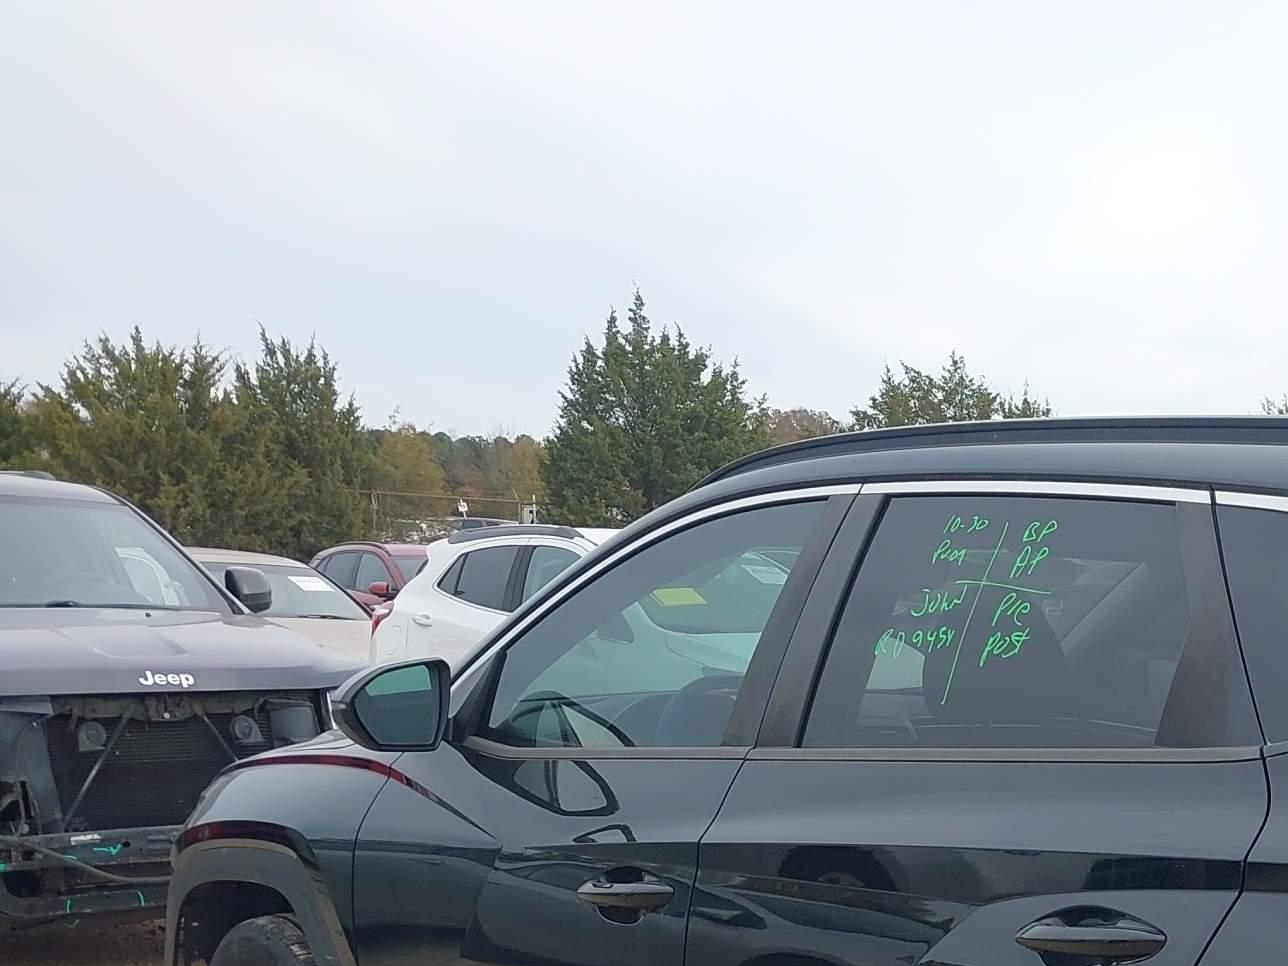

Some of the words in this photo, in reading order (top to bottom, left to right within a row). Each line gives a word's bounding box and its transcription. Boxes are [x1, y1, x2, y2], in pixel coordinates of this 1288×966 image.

[943, 514, 990, 535] 10-30
[1022, 520, 1058, 543] BP
[1009, 545, 1050, 578] AP
[138, 670, 195, 688] Jeep
